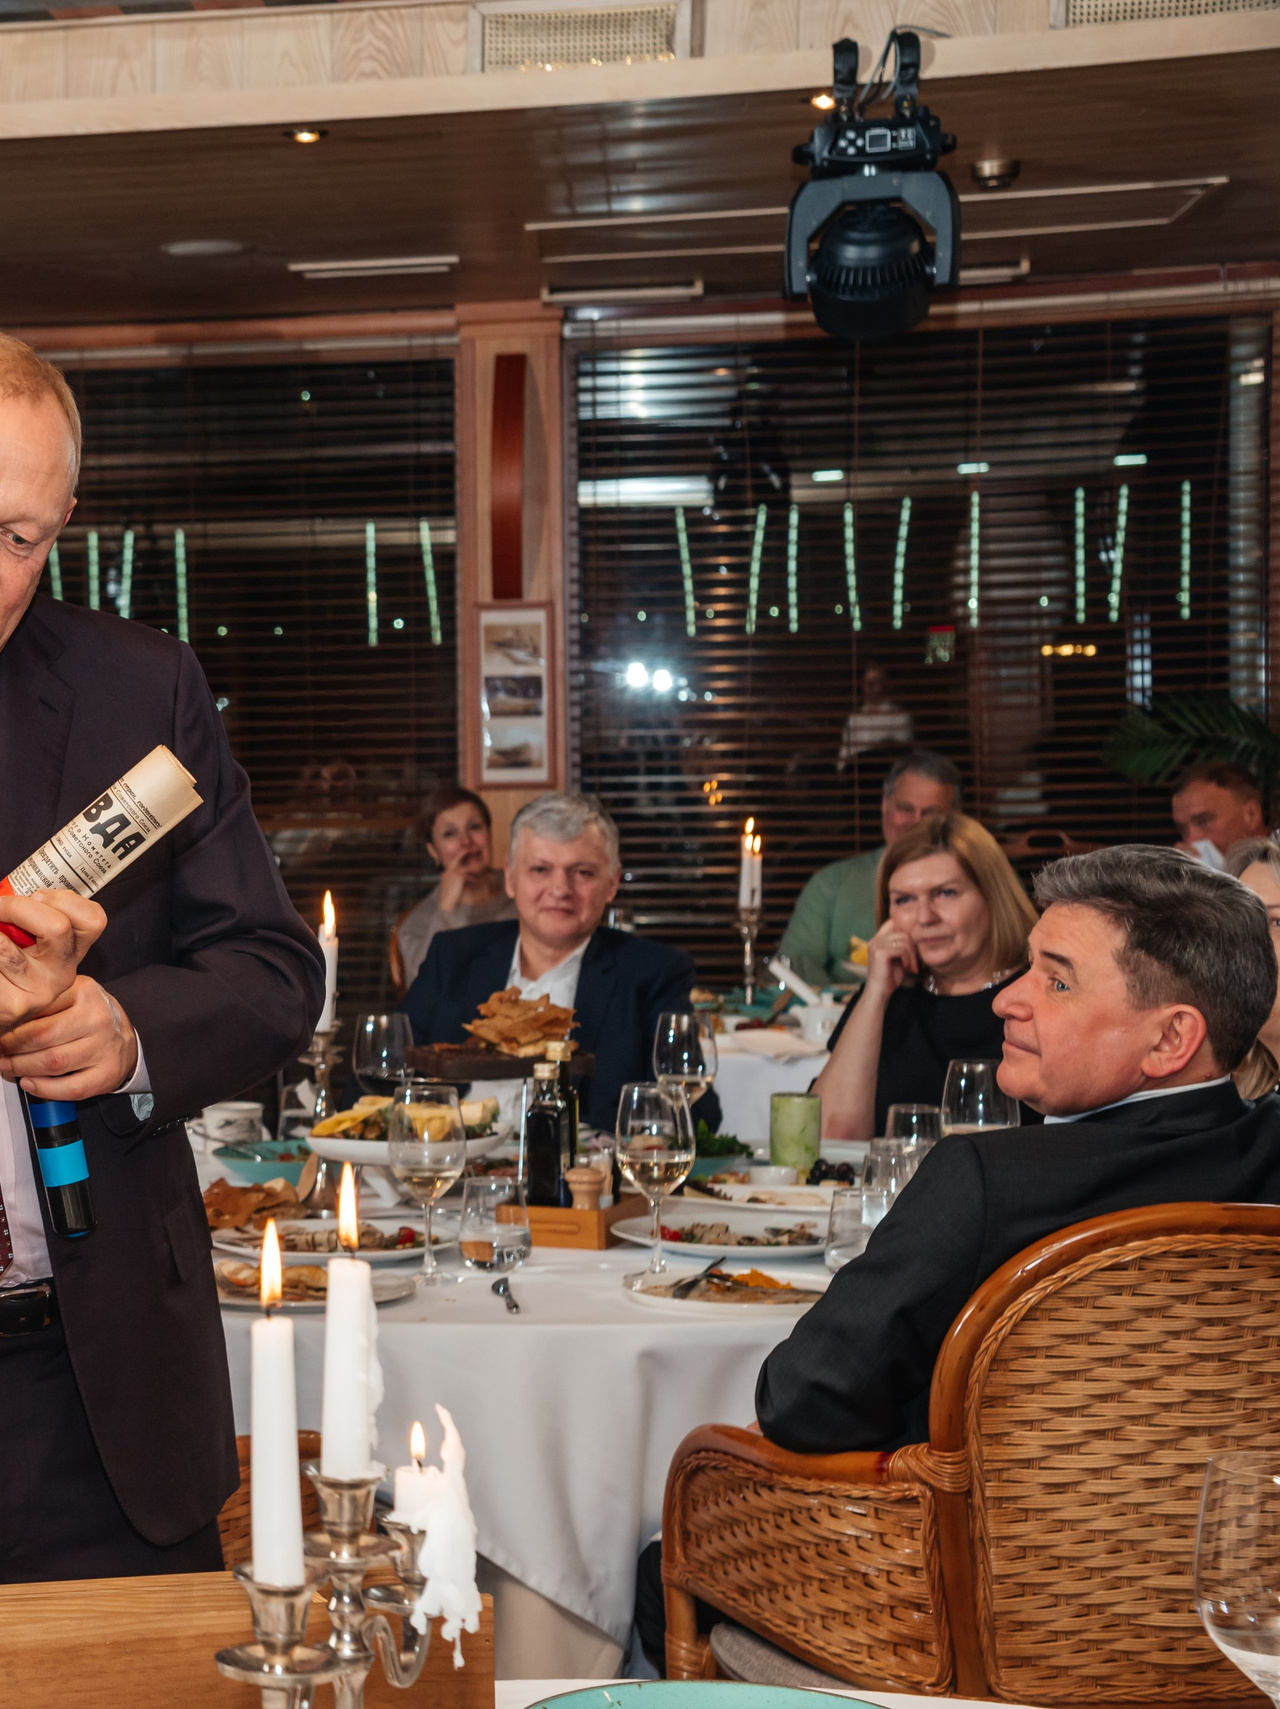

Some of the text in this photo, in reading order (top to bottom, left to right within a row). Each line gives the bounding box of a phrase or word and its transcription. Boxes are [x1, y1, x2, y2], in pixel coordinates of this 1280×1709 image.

[115, 788, 140, 820] Советского
[66, 826, 93, 858] Советского
[81, 792, 146, 861] ВДА
[81, 833, 112, 869] Комитета
